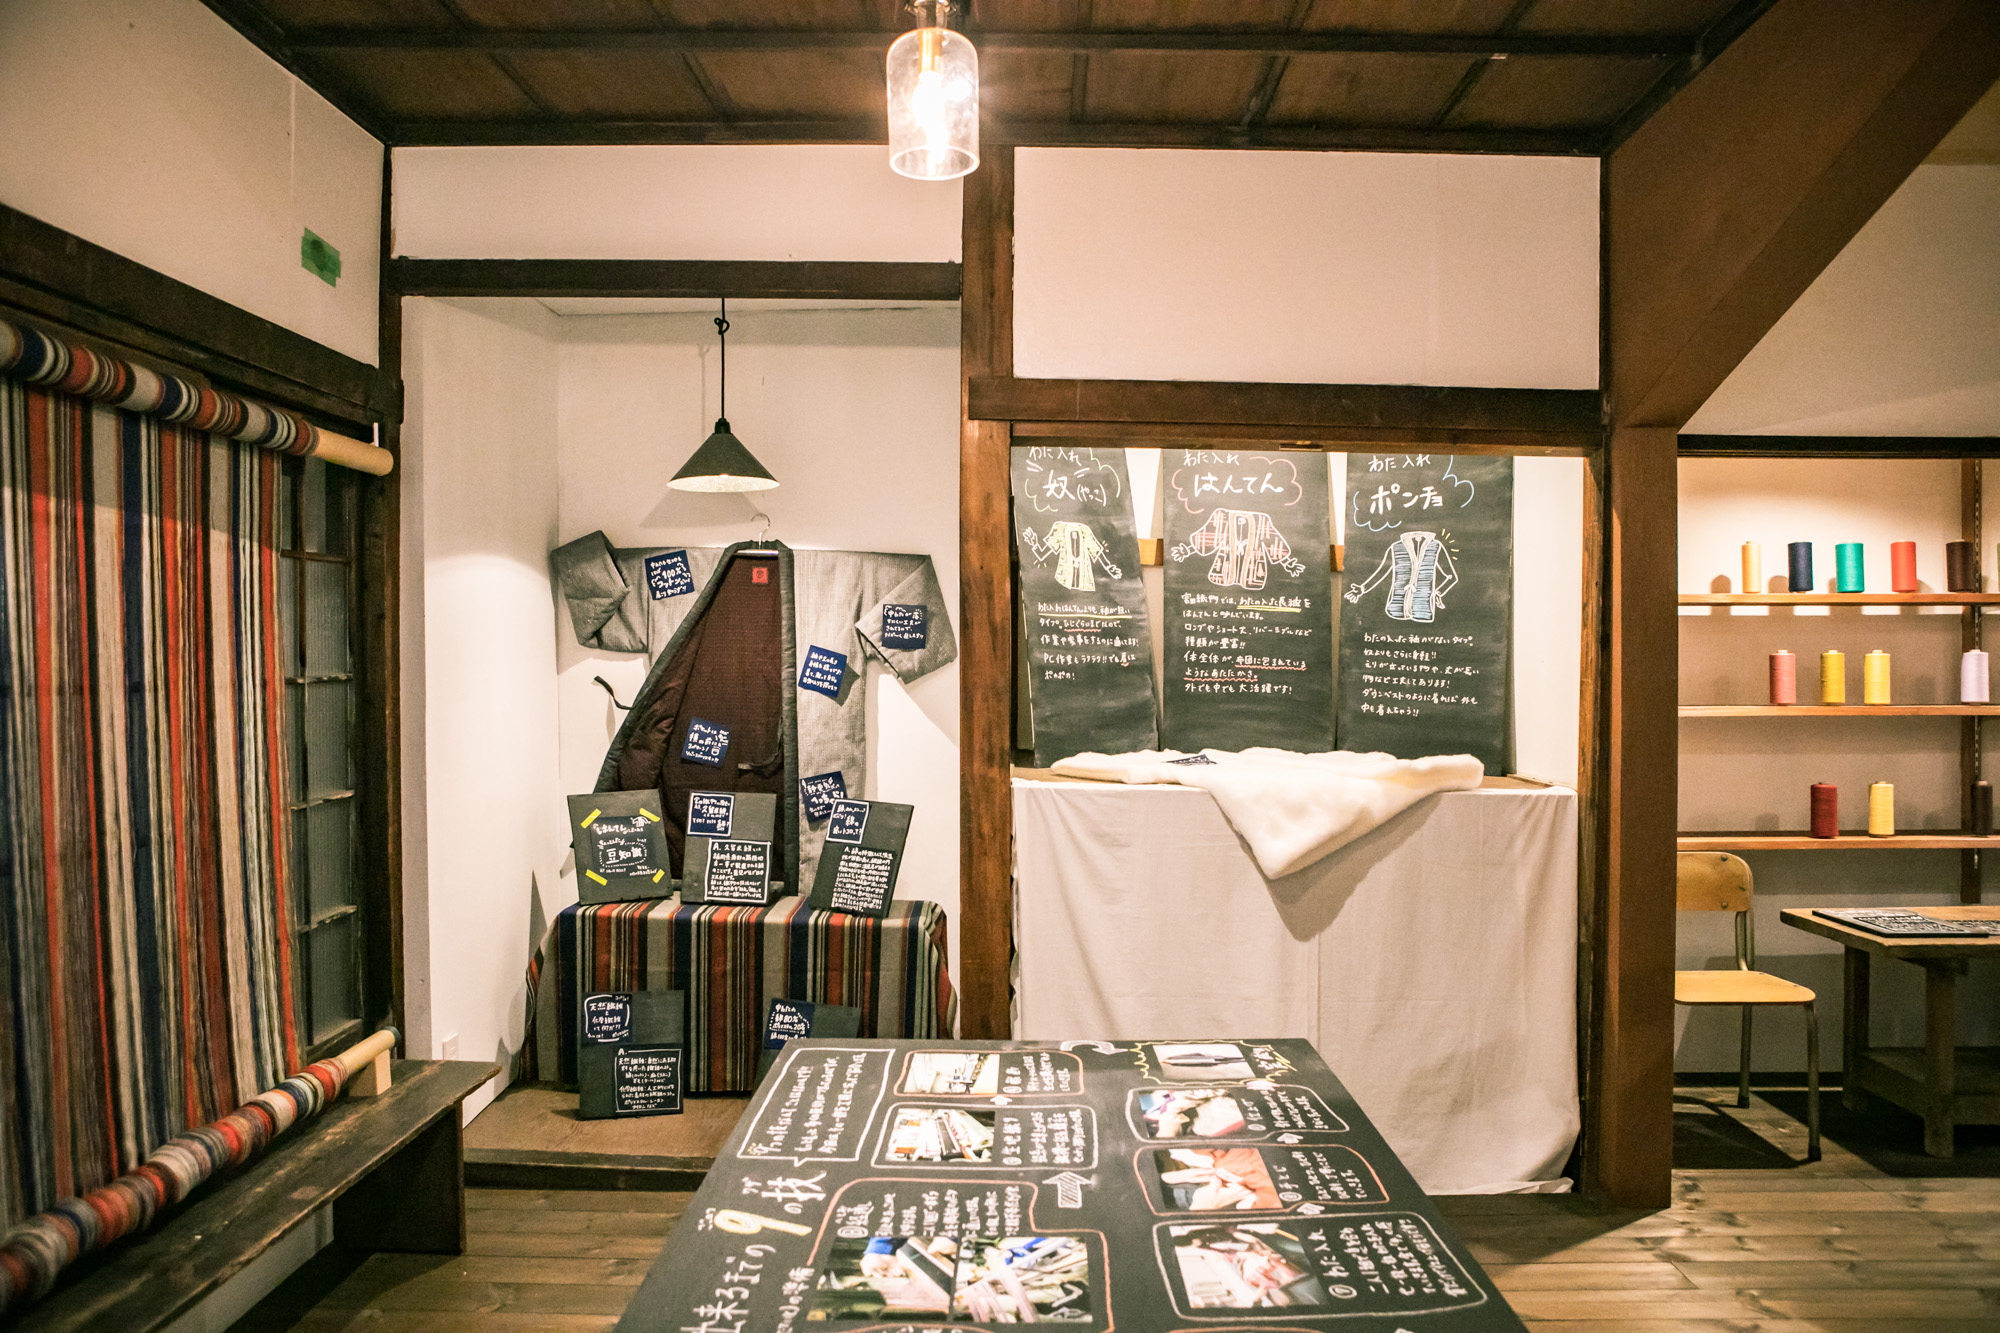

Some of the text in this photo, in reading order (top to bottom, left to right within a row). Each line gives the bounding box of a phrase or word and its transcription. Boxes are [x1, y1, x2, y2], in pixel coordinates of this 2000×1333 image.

[1183, 449, 1240, 466] わた入れ
[1368, 453, 1431, 472] わた入れ
[1194, 472, 1284, 497] はんてん
[1369, 483, 1443, 515] ポンチョ
[1183, 610, 1264, 620] はんてんと呼んでいます。
[1185, 636, 1246, 649] 種類が豊富!!
[1185, 667, 1258, 679] ようなあたたかさ。
[1185, 683, 1292, 694] 外でも中でも大活躍です!
[713, 842, 721, 850] A.
[606, 846, 642, 864] 豆知識
[589, 1002, 623, 1011] 天然繊維
[592, 1016, 621, 1024] 化学繊維
